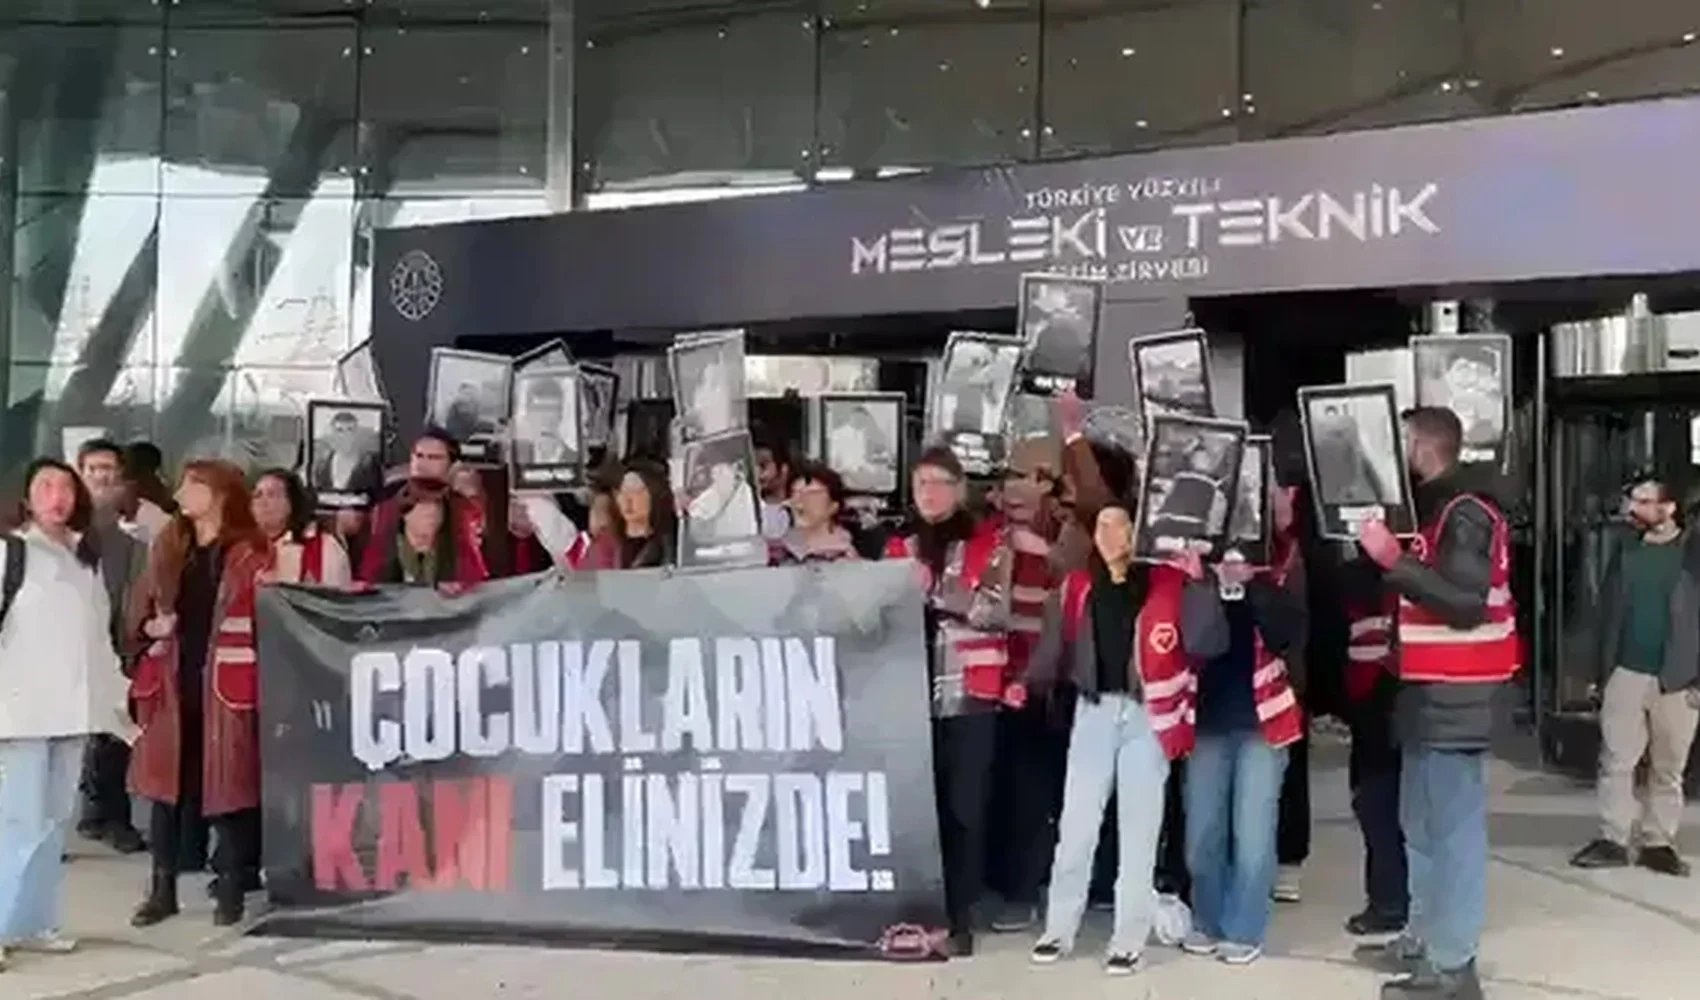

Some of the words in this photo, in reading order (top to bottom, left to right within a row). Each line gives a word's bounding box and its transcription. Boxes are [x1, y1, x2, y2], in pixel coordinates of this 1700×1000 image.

[851, 207, 1106, 274] MESLEKİ
[1172, 182, 1441, 249] TEKNİK
[350, 636, 843, 770] ÇOCUKLARIN
[310, 776, 515, 891] KANI
[541, 757, 895, 891] ELİNİZDE!
